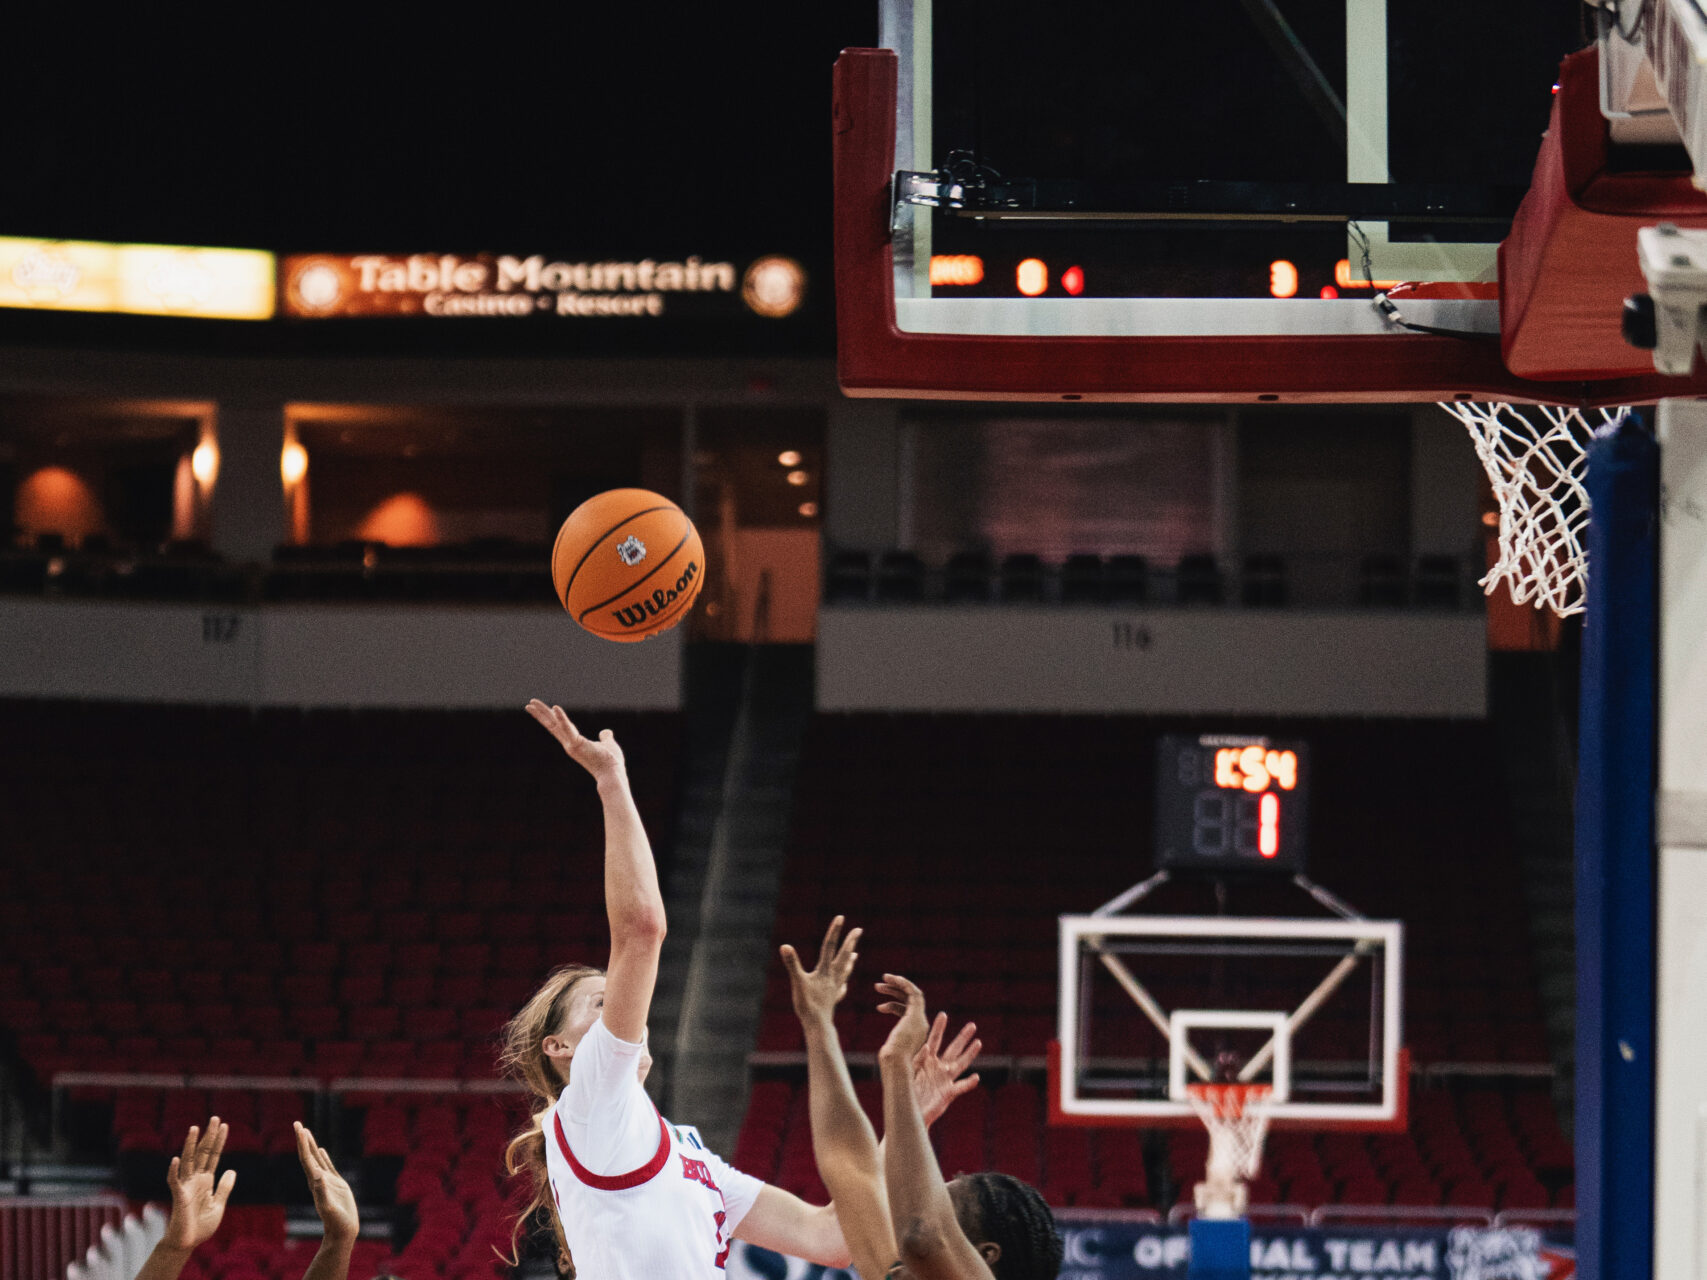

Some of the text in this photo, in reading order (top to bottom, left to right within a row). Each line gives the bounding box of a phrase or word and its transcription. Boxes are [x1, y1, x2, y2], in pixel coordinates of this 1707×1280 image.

[350, 254, 736, 292] Table Mountain
[424, 293, 663, 316] Casino Resort
[612, 561, 698, 628] Wilson
[1134, 1236, 1314, 1270] OFIAL
[1325, 1240, 1437, 1271] TEAM
